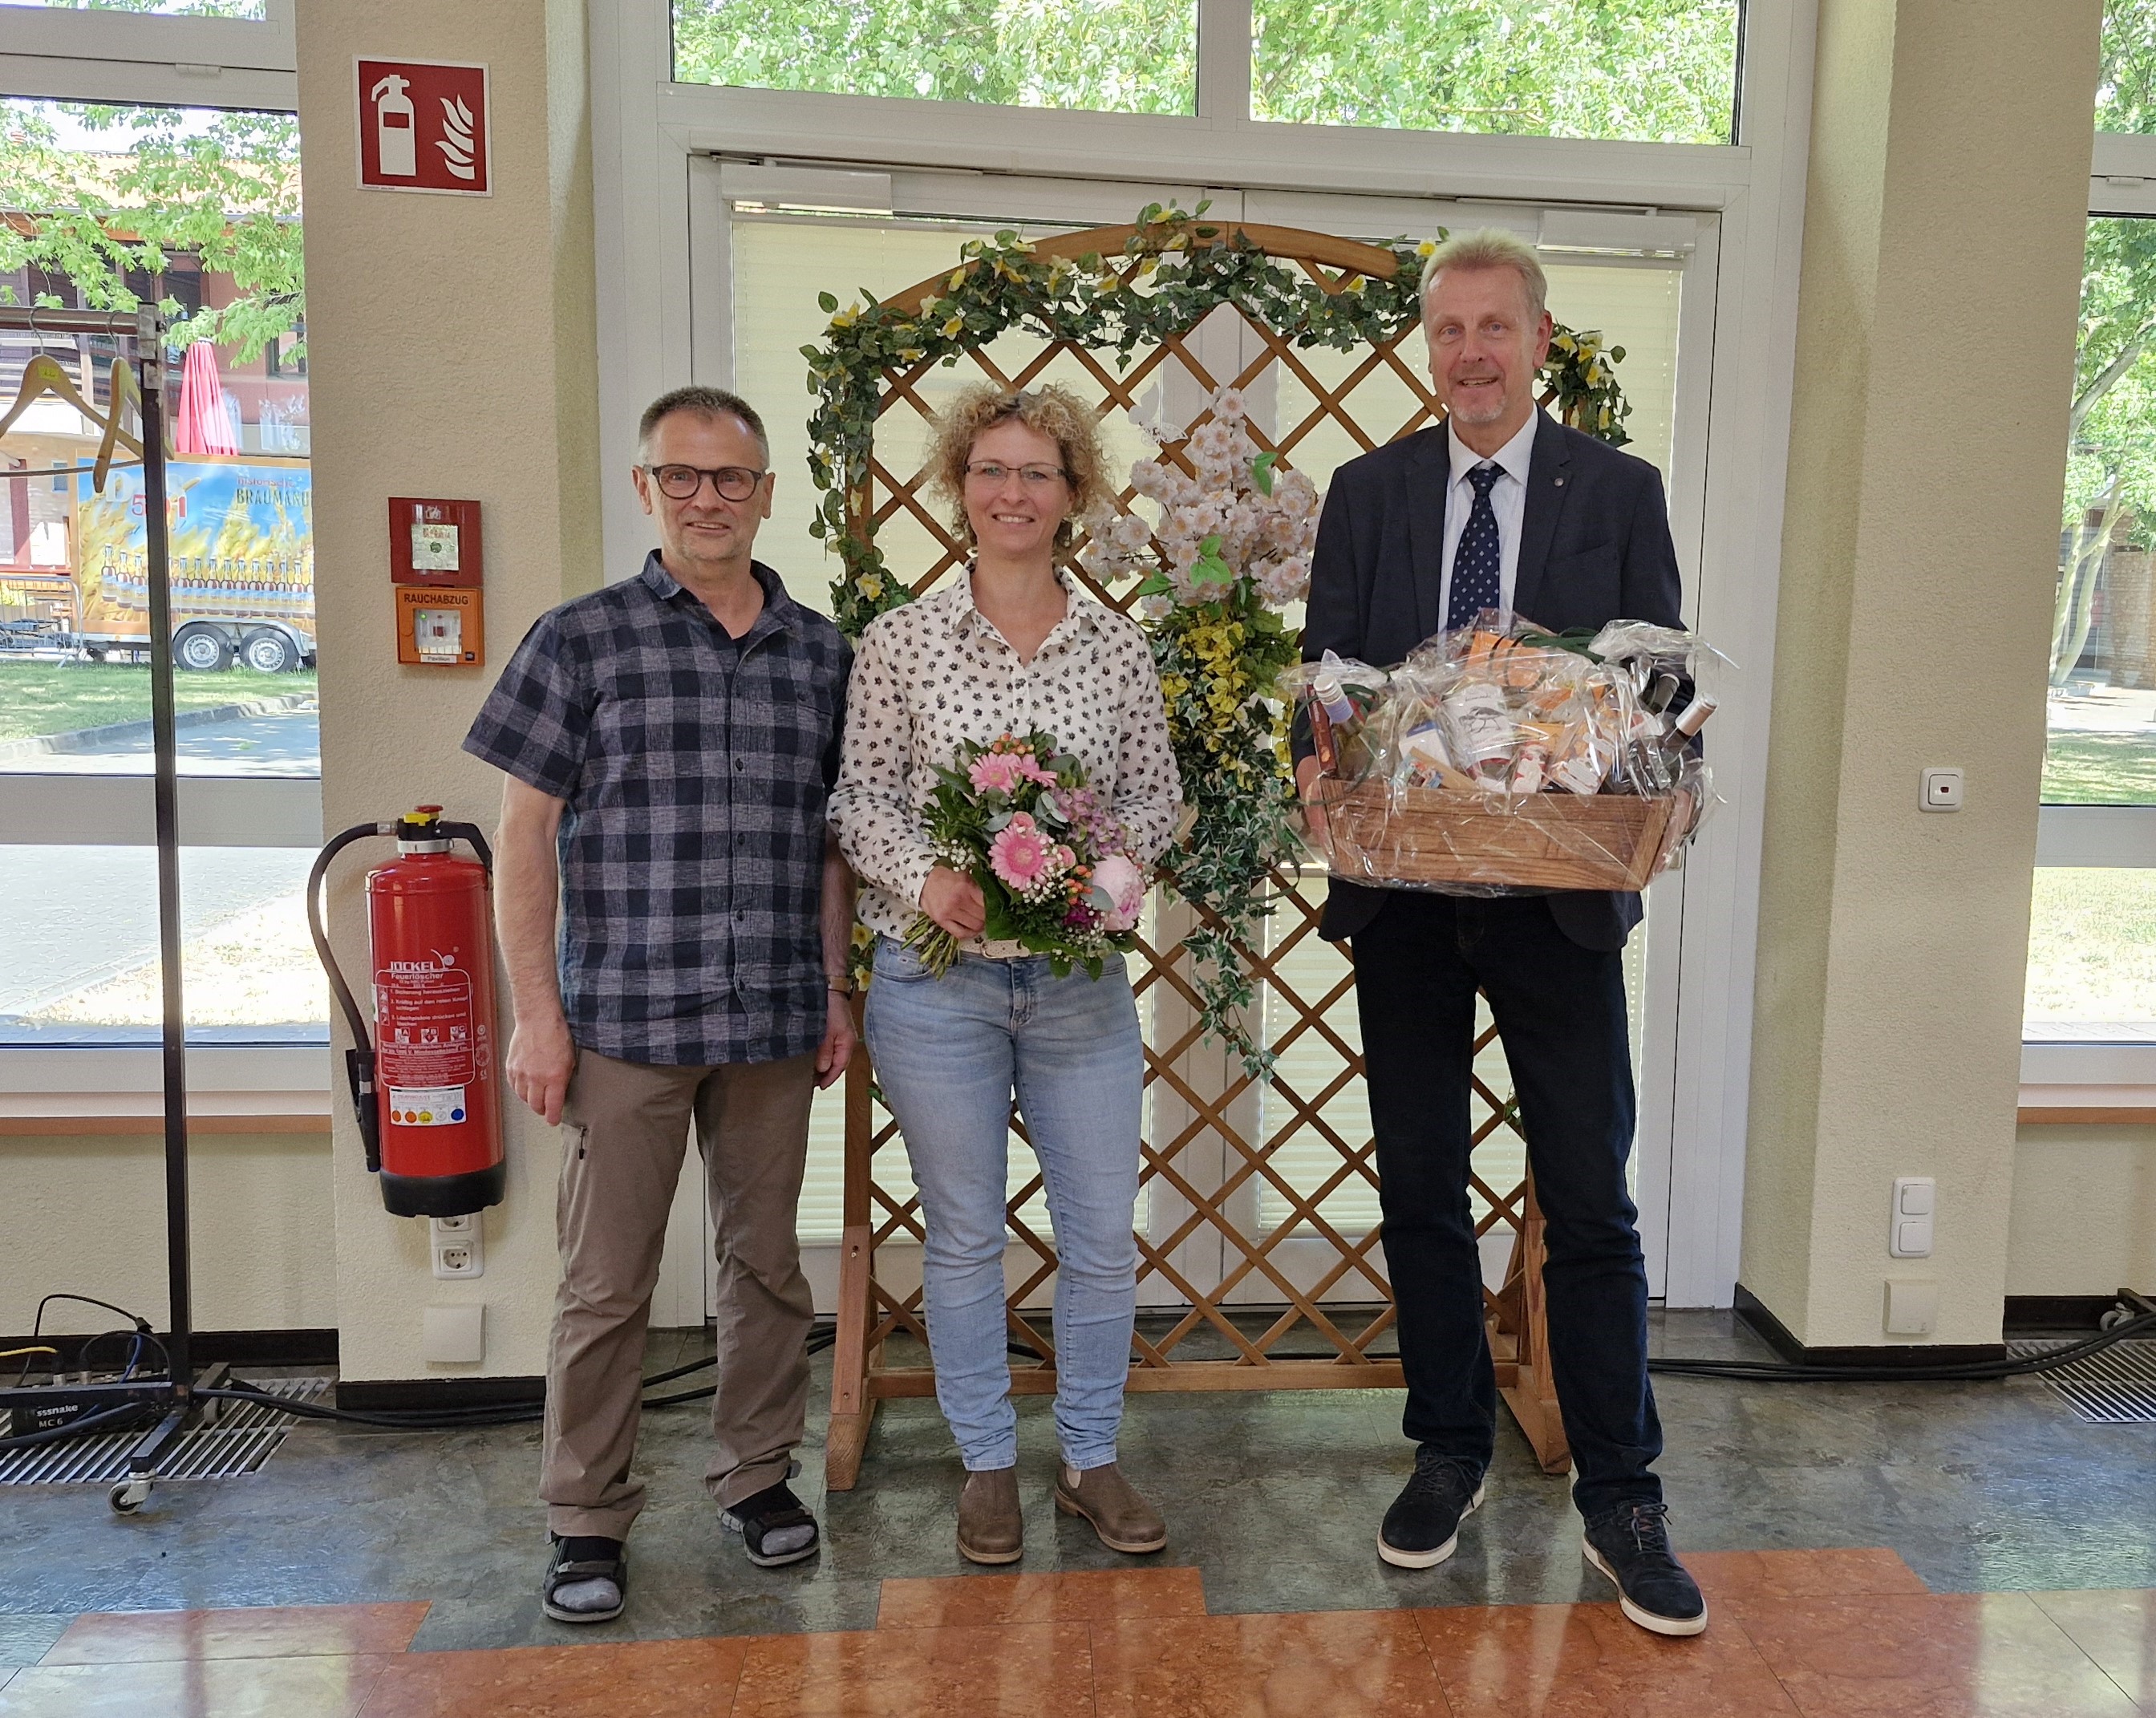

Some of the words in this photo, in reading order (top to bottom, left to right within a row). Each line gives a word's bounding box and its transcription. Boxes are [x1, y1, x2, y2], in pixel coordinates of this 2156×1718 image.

[403, 593, 469, 605] RAUCHABZUG
[391, 972, 444, 980] Feuerlöscher
[36, 1404, 79, 1417] sssnake
[38, 1419, 56, 1428] MC
[57, 1417, 63, 1425] 6
